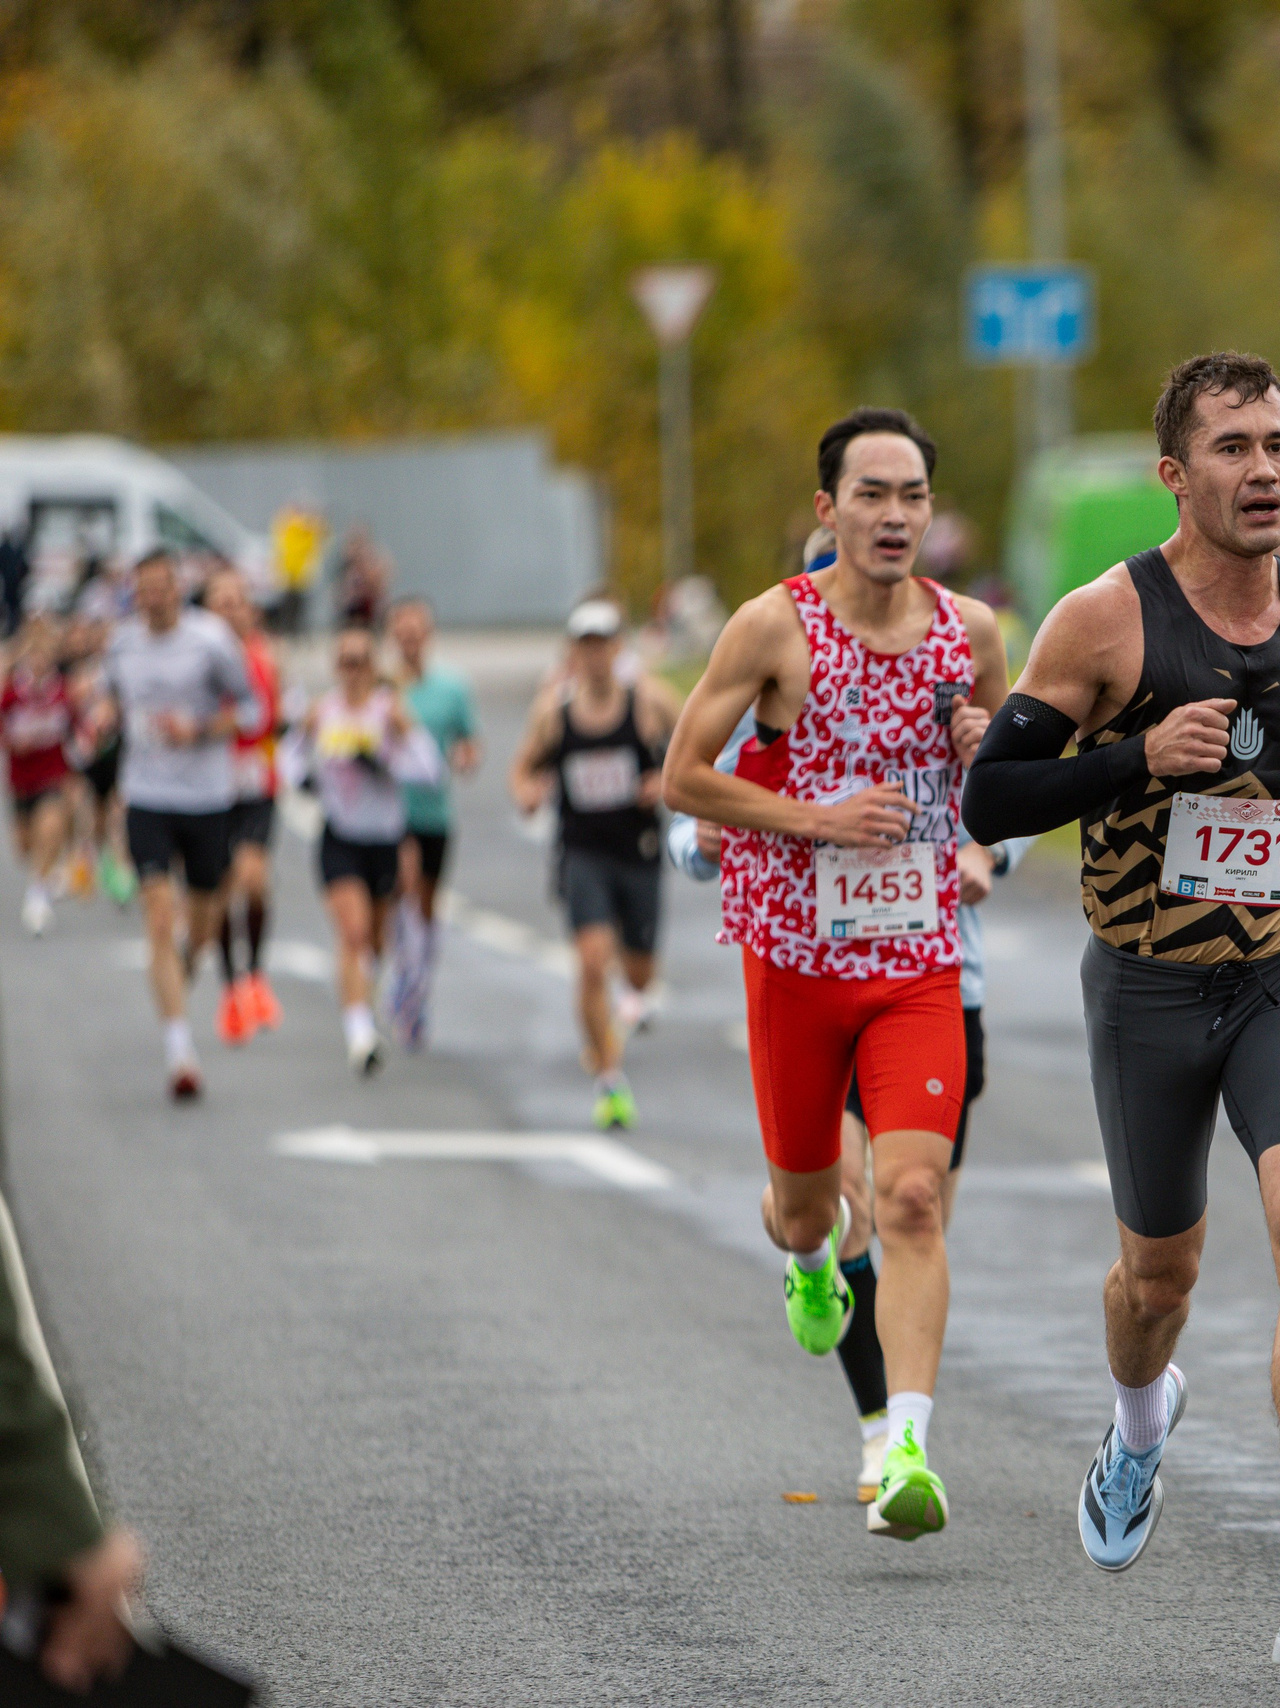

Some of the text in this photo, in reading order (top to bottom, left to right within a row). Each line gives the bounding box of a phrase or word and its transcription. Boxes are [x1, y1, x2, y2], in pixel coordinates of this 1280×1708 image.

[1187, 801, 1199, 811] 10
[1225, 868, 1258, 877] КИРИЛЛ
[833, 869, 923, 907] 1453
[1181, 881, 1191, 894] B
